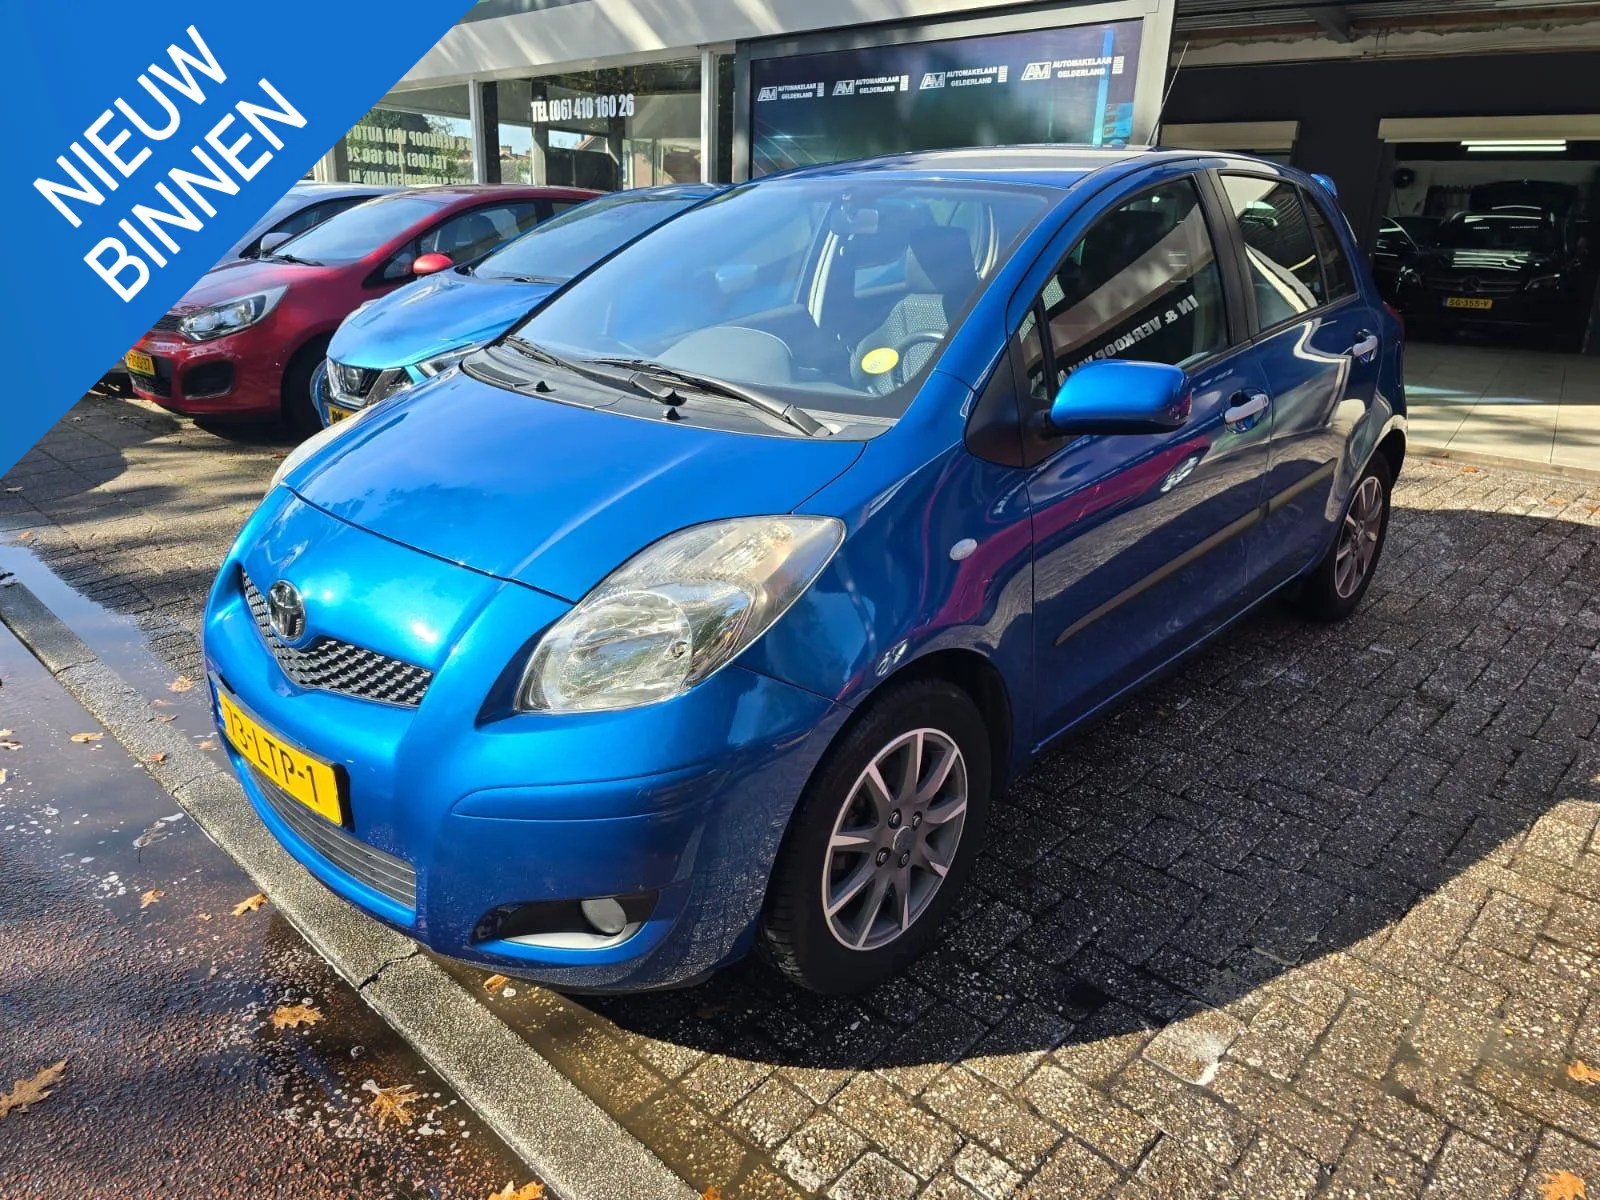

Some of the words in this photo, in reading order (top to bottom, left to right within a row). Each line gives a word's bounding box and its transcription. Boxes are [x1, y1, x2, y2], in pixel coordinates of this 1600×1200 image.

[1052, 56, 1112, 69] AUTOMAKELAAR
[946, 66, 998, 78] AUTOMAKELAAR
[1056, 67, 1106, 78] GELDERLAND
[950, 76, 993, 87] GELDERLAND
[573, 97, 594, 119] 410
[595, 95, 617, 118] 160
[618, 93, 635, 117] 26
[224, 702, 321, 804] 73-LTP-1
